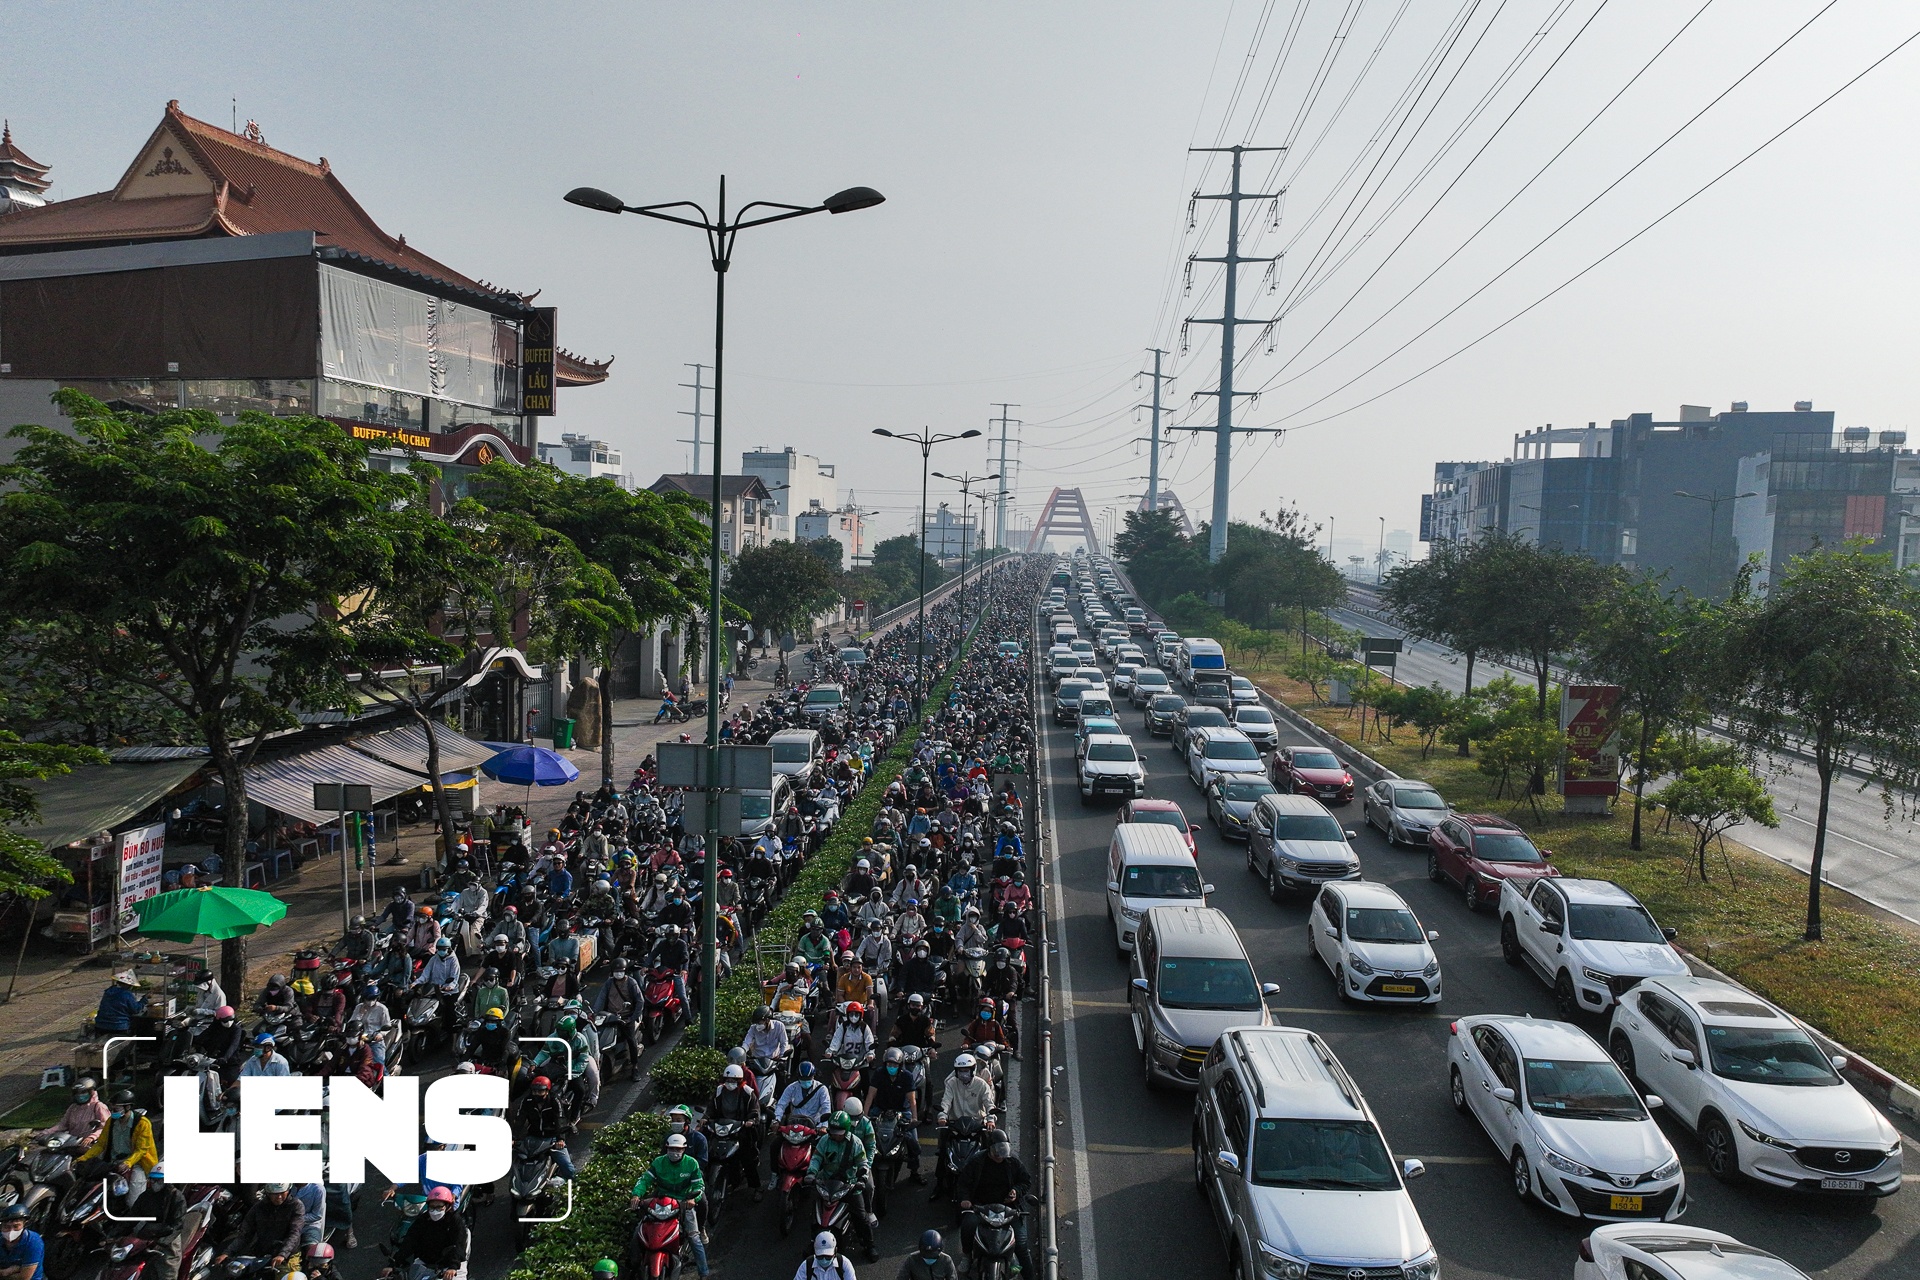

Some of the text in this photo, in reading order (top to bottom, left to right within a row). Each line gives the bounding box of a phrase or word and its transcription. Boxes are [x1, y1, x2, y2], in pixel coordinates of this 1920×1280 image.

[525, 348, 552, 363] BUFFET
[529, 368, 547, 388] LẨU
[525, 395, 551, 409] CHAY
[353, 426, 387, 440] BUFFET
[410, 435, 431, 448] CHAY
[1575, 726, 1591, 736] 49
[123, 843, 138, 860] BÚN
[140, 838, 149, 855] BÒ
[151, 830, 165, 852] HUẾ
[846, 1042, 862, 1054] 25
